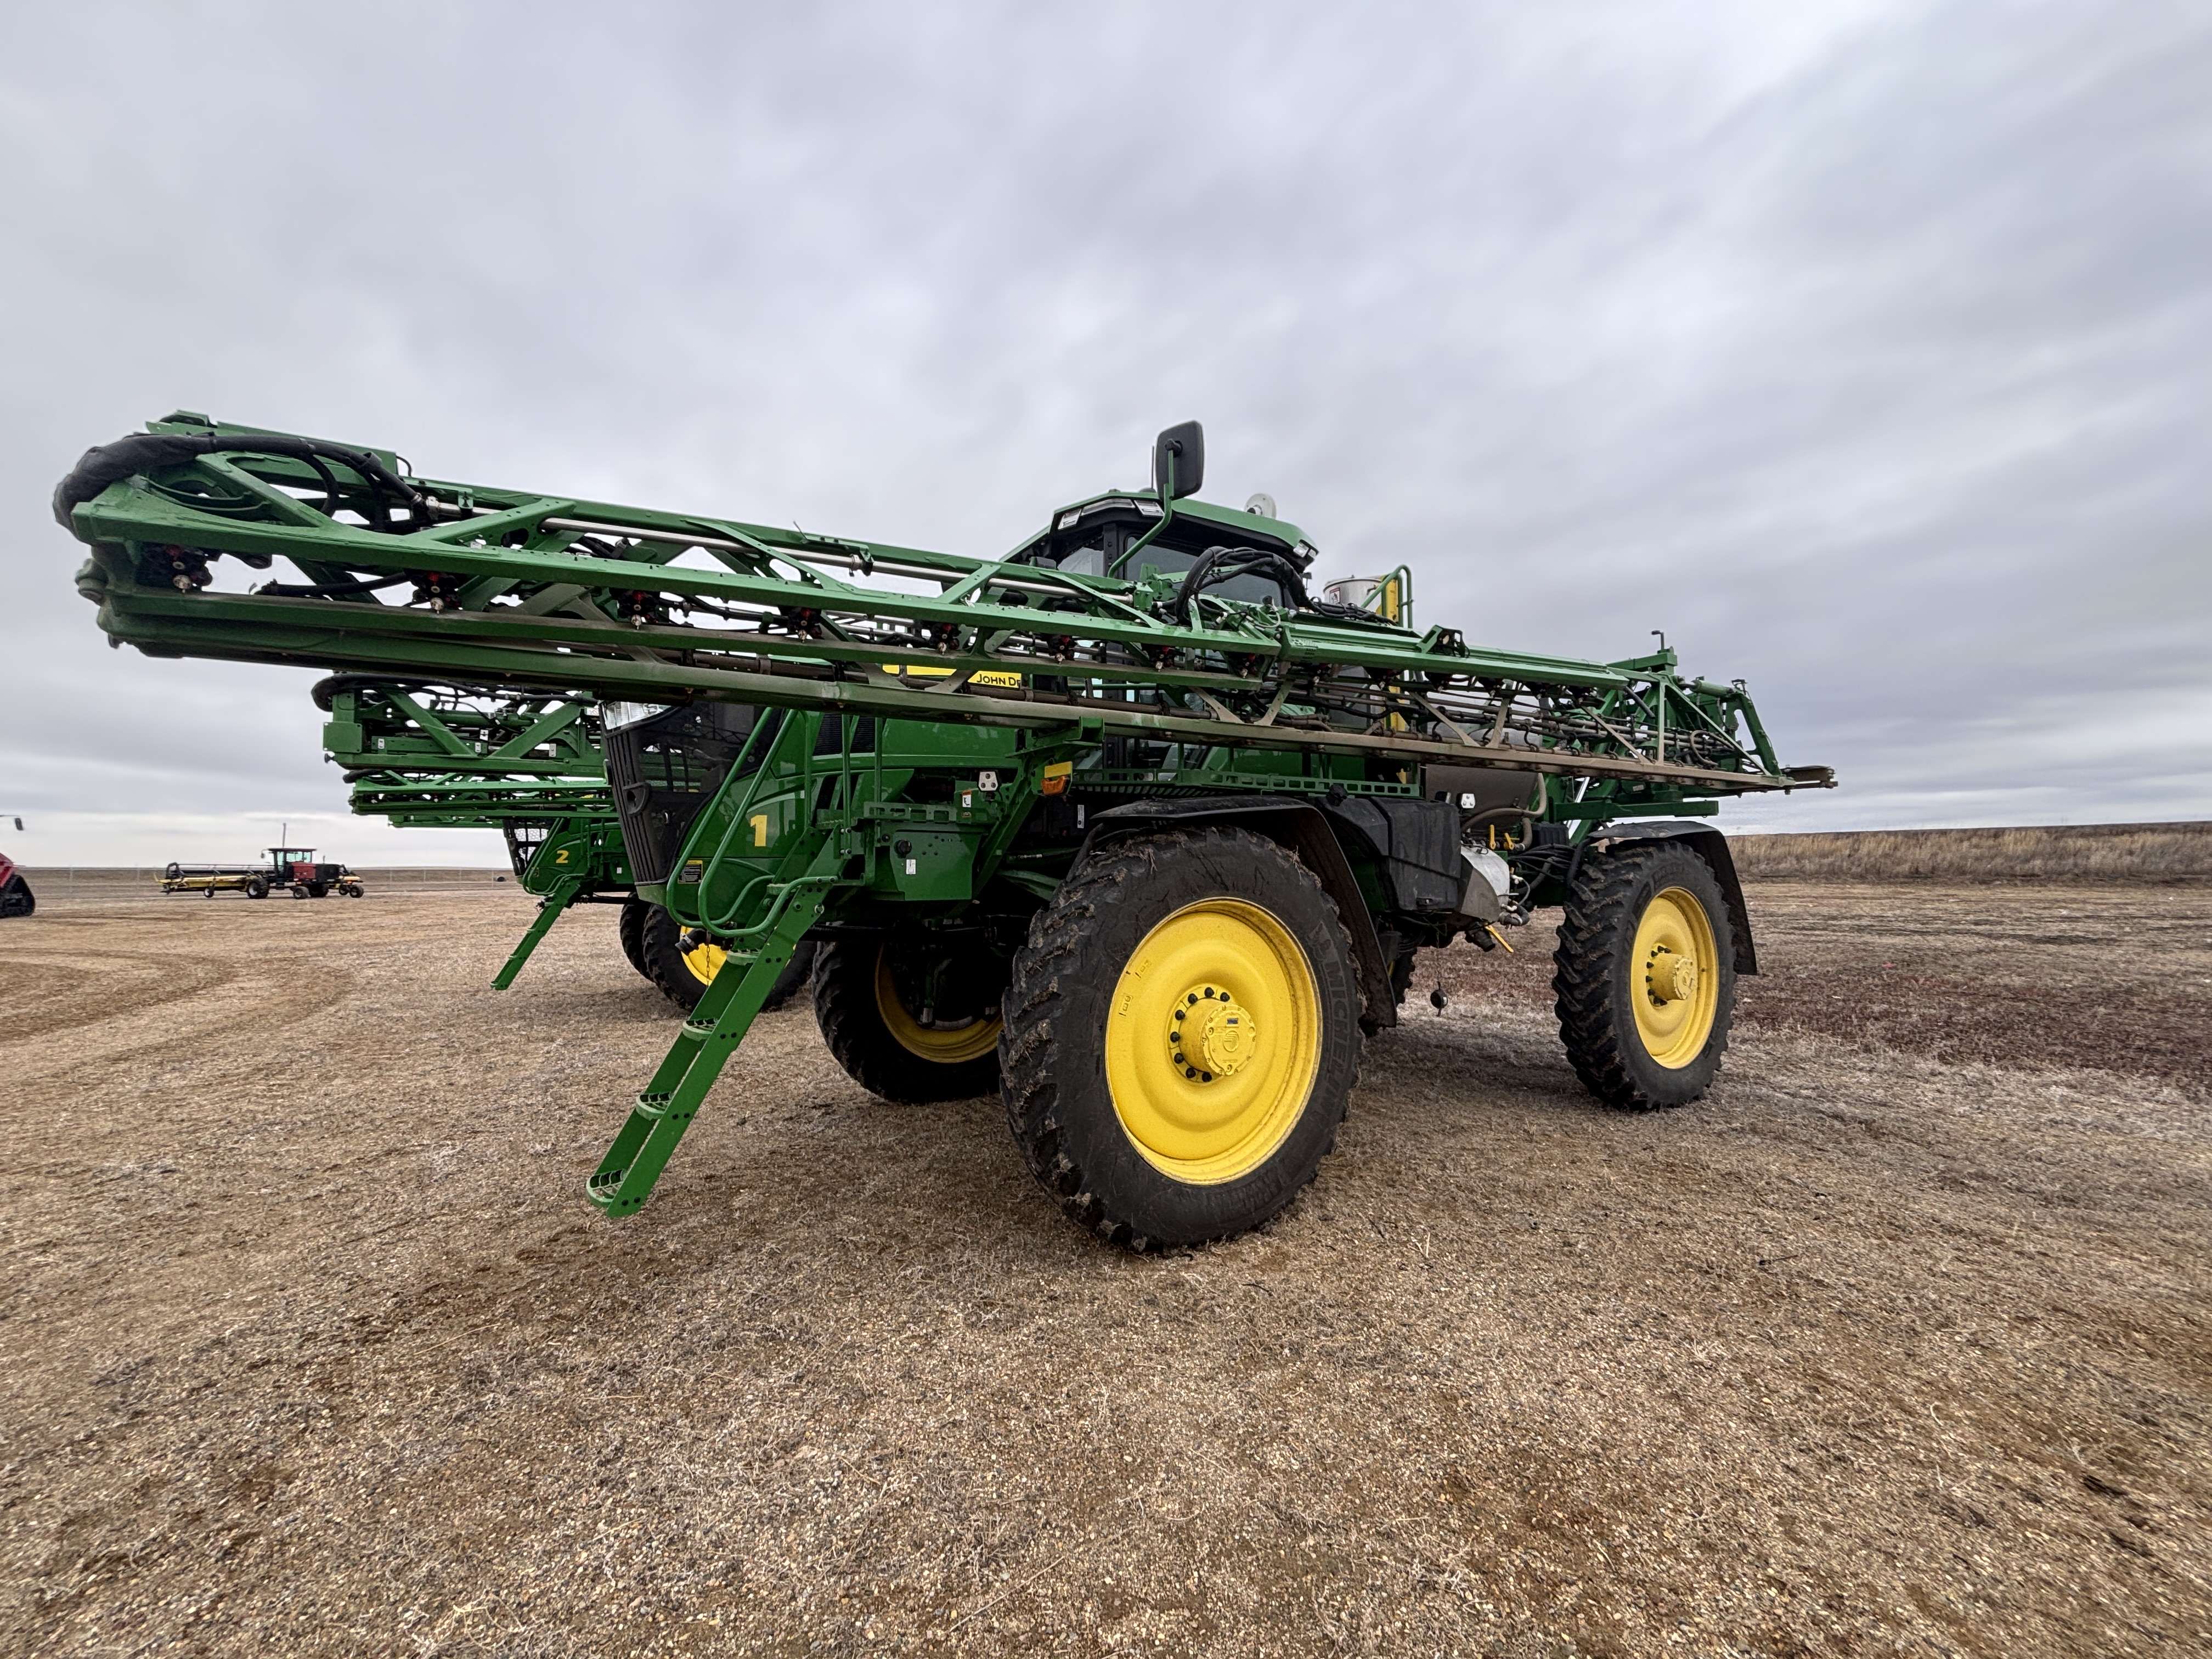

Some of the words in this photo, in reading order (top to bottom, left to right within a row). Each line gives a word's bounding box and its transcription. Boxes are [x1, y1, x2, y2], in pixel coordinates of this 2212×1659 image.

[977, 674, 1006, 685] JOHN
[750, 815, 768, 847] 1
[556, 850, 569, 864] 2
